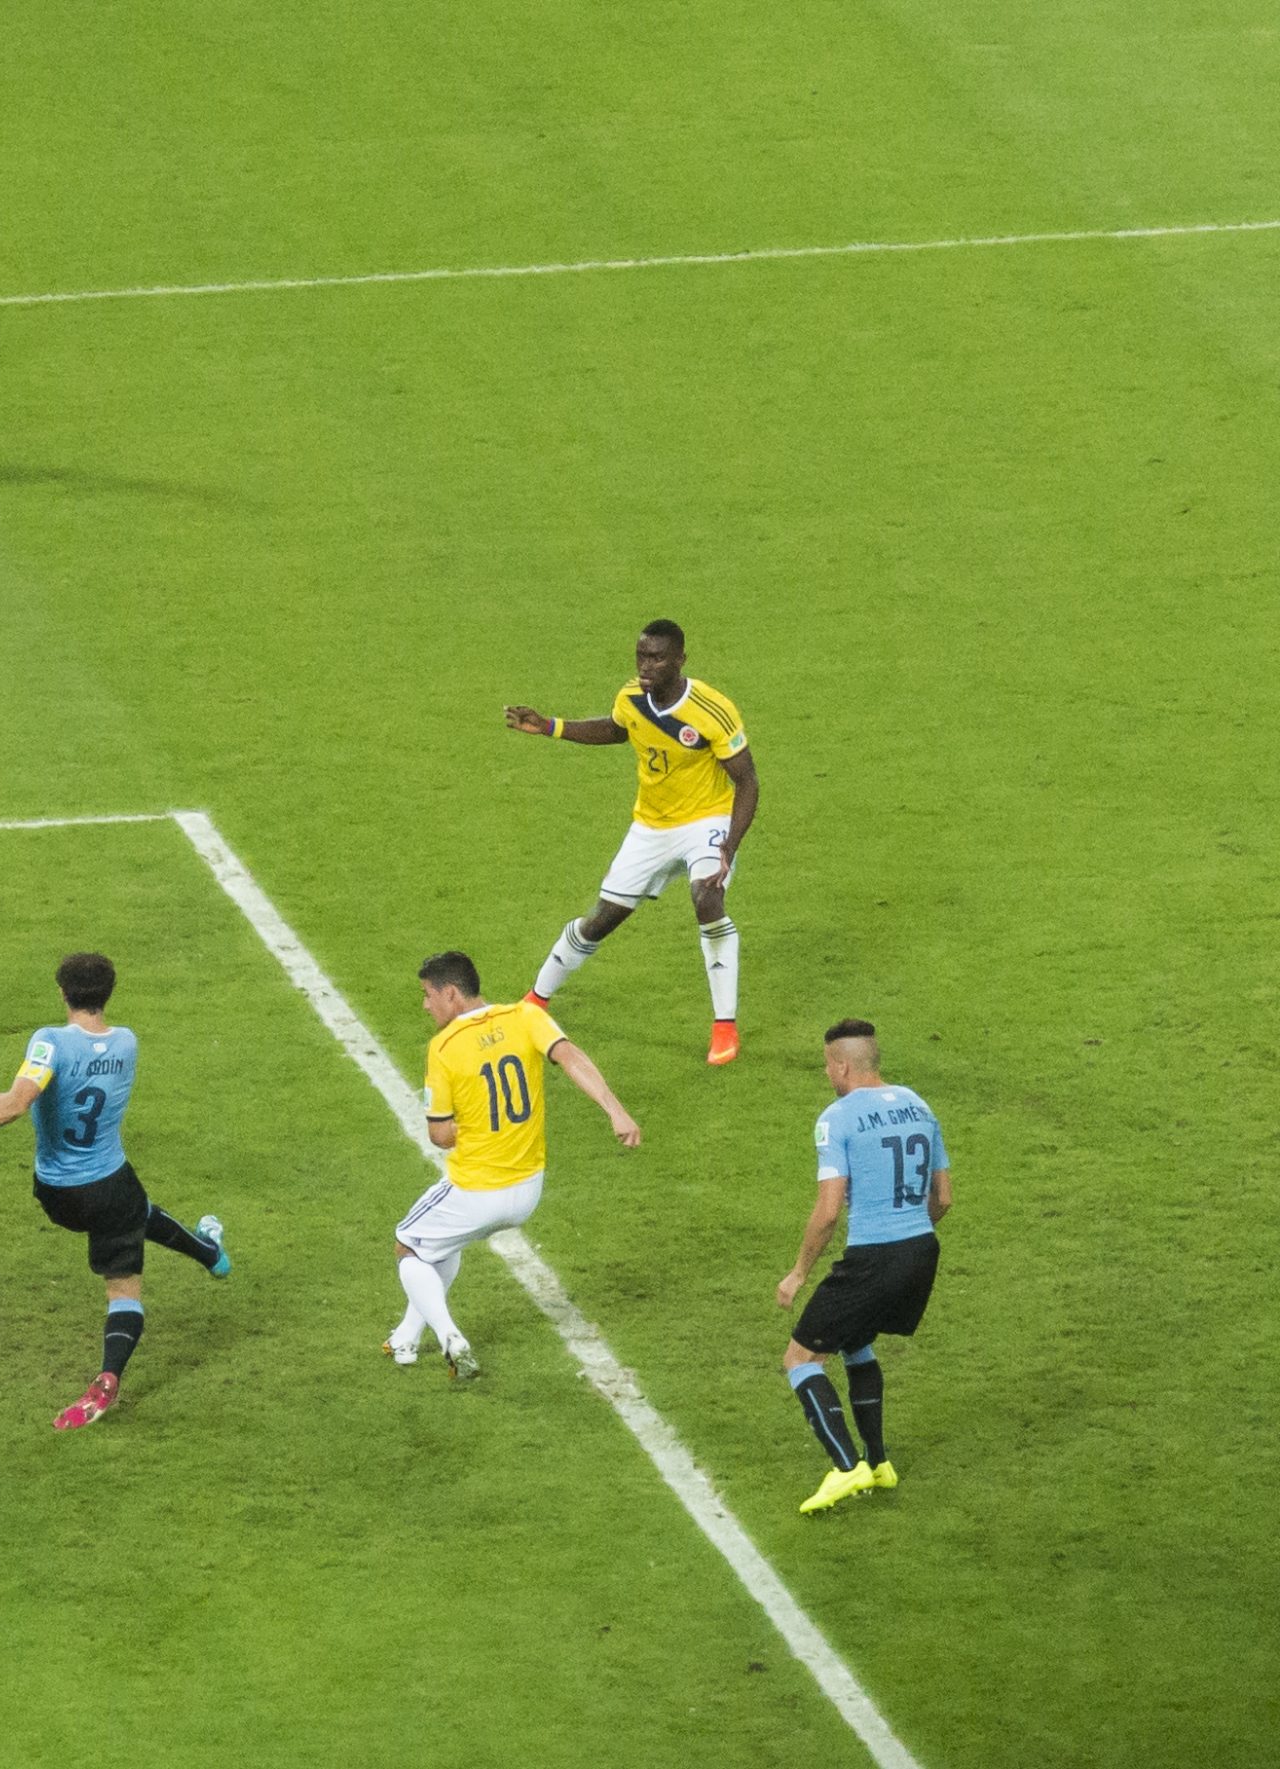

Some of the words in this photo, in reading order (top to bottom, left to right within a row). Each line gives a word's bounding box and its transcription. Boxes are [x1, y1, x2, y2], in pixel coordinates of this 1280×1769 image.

[647, 747, 669, 774] 21
[63, 1086, 107, 1147] 3
[480, 1054, 531, 1132] 10
[881, 1133, 930, 1208] 13
